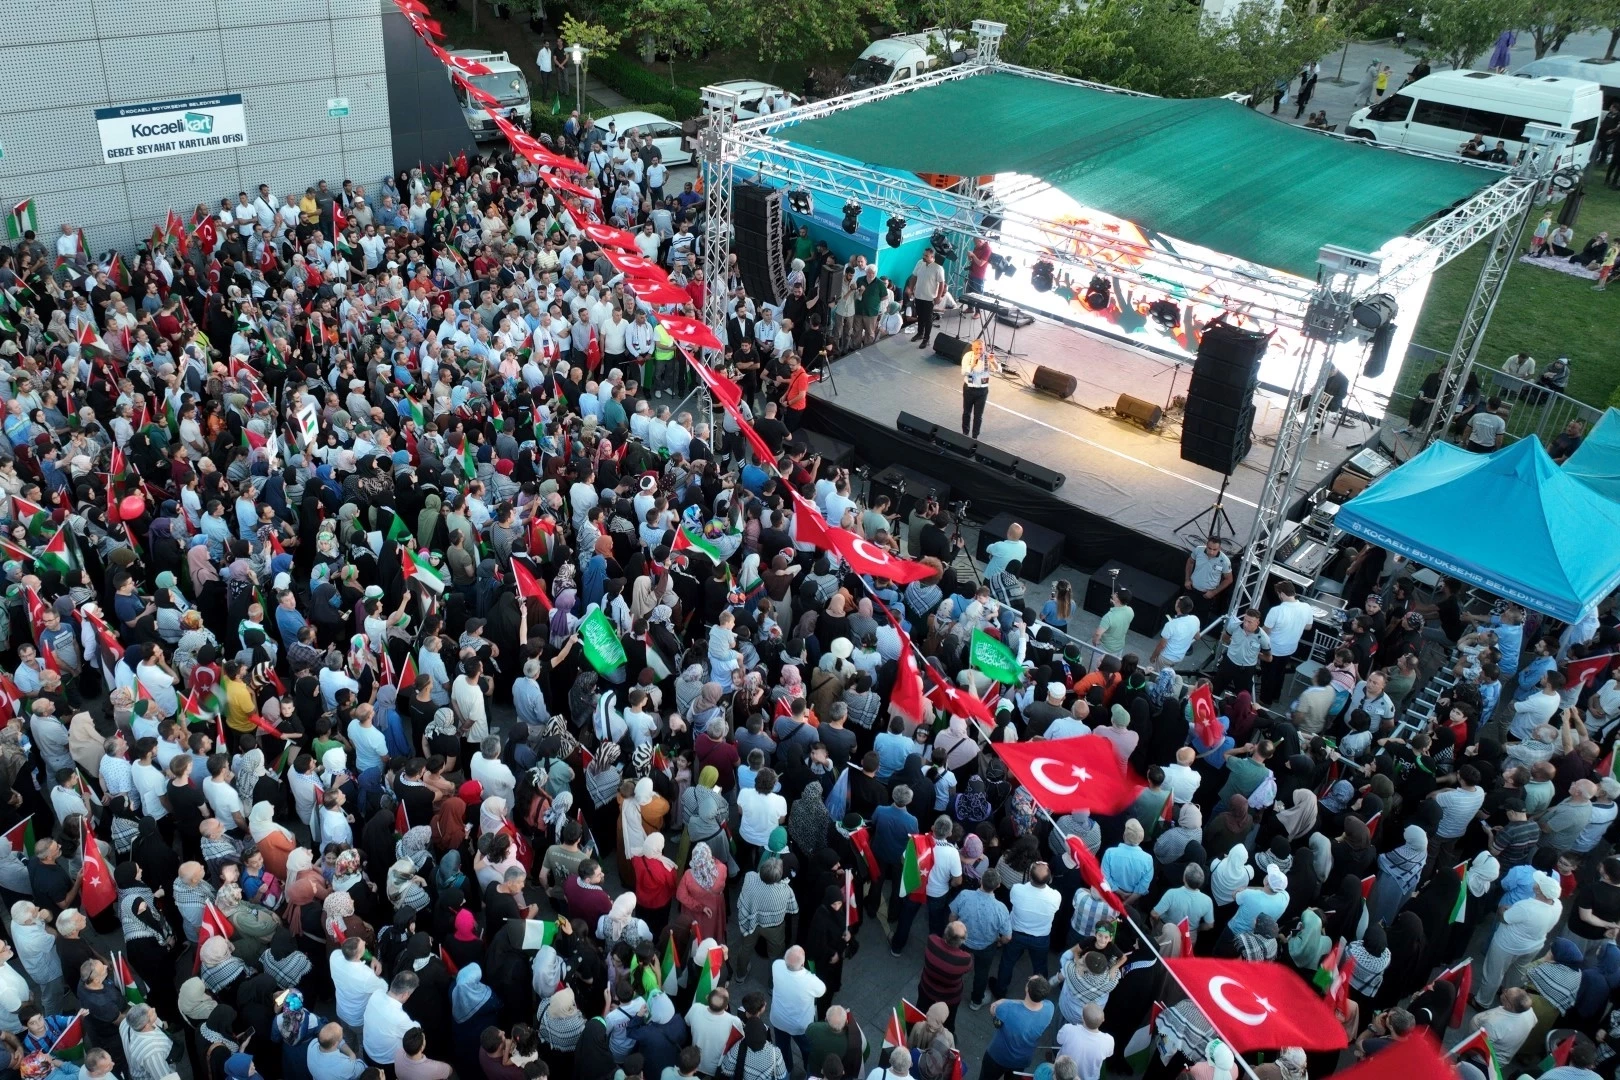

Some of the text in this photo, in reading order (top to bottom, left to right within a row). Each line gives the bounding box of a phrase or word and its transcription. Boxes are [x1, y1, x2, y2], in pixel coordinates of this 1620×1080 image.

[1550, 131, 1566, 139] TAF
[107, 133, 243, 158] GEBZE SEYAHAT KARTLARI OFİSİ
[1350, 257, 1368, 268] TAF
[1363, 528, 1409, 552] KOCAELİ
